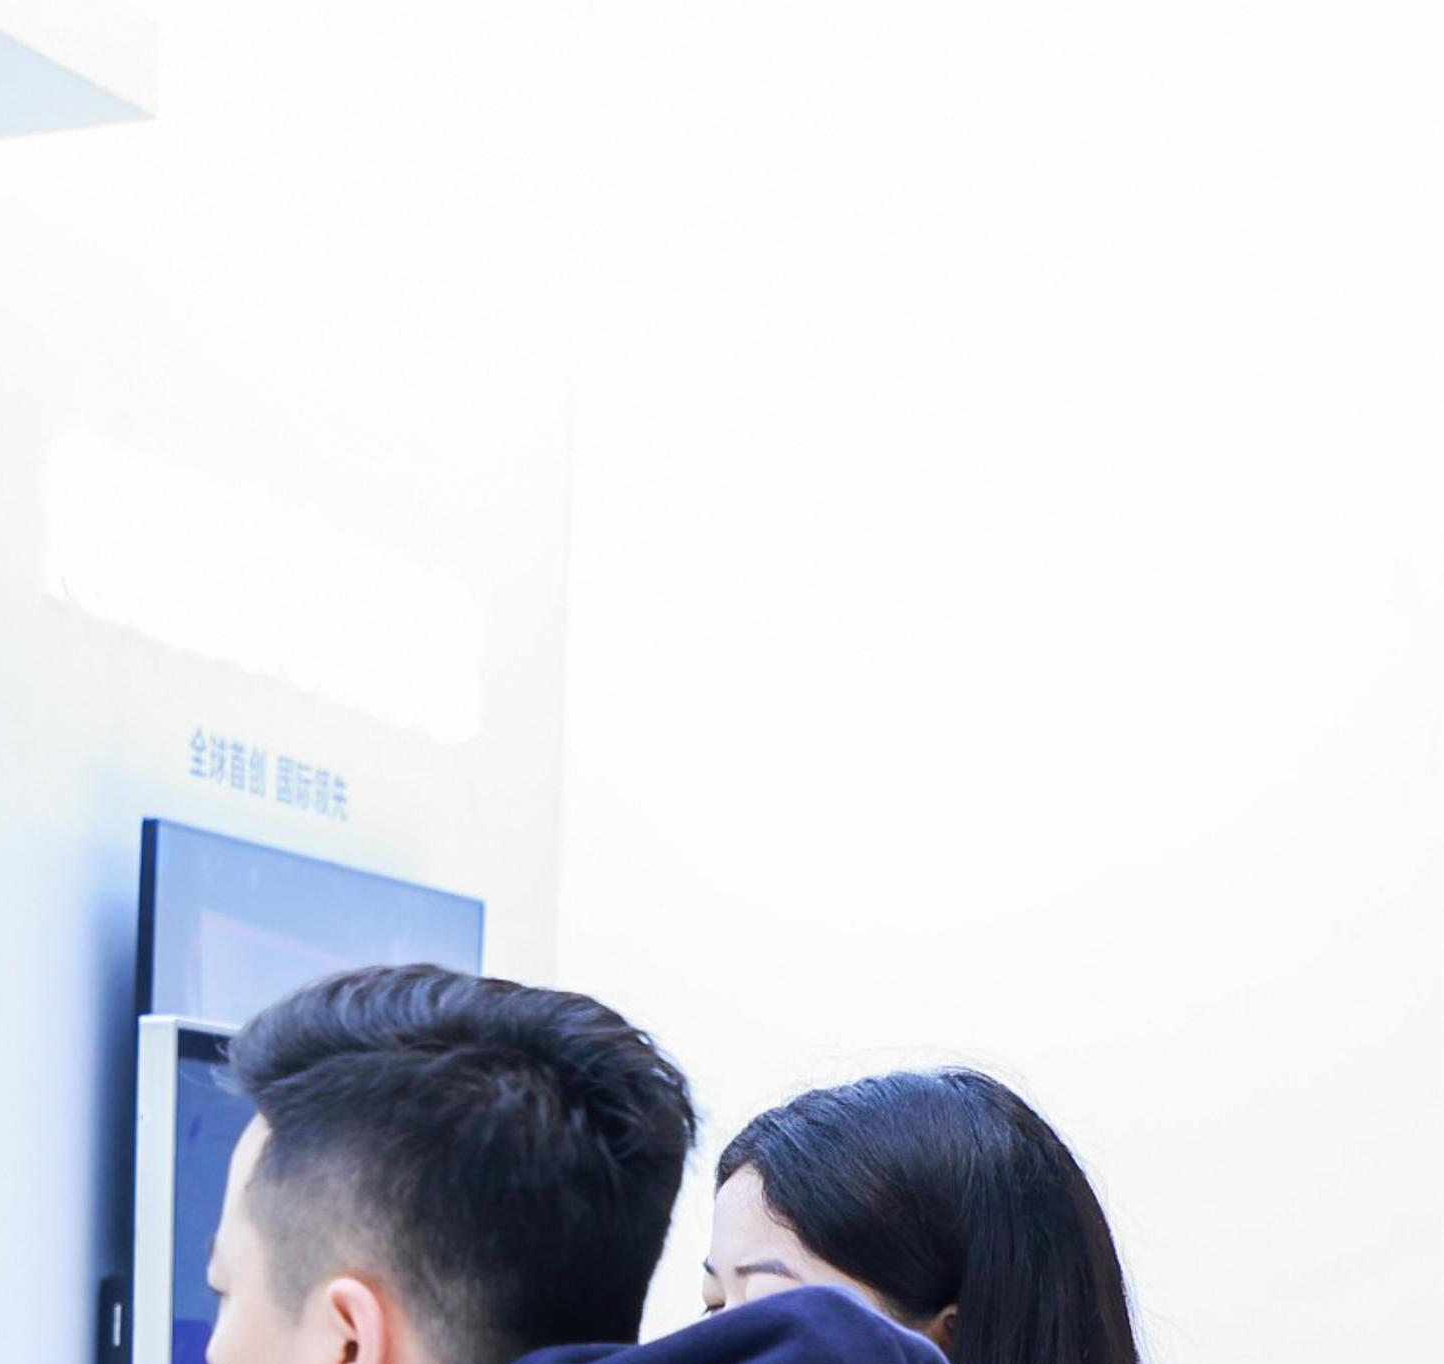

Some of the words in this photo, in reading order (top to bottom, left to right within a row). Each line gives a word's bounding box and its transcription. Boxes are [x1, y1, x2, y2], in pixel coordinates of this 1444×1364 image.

[190, 727, 266, 797] 全球首创
[277, 753, 347, 821] 国际领先
